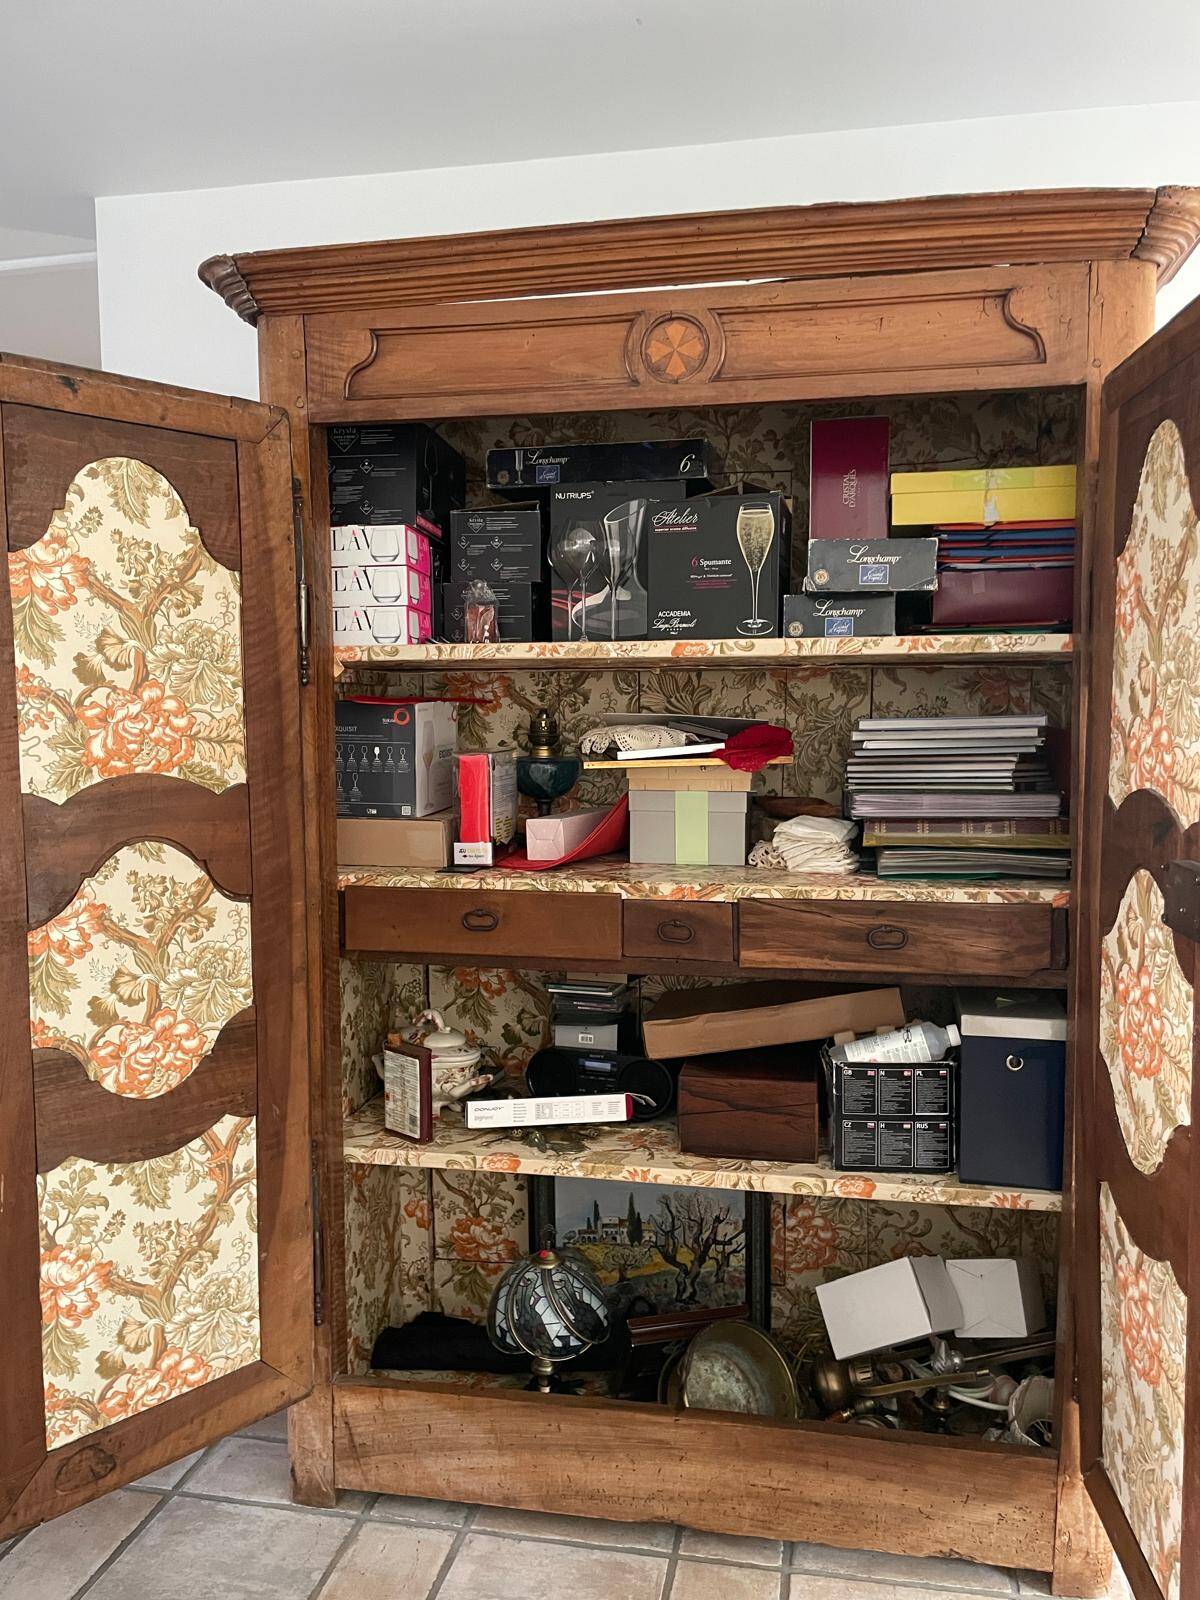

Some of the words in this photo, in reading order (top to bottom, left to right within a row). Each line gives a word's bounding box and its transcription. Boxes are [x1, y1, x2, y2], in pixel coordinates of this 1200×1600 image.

[680, 454, 696, 473] 6
[842, 473, 850, 505] CRISTAL
[651, 507, 698, 527] Atelier
[699, 558, 732, 568] Spumante
[847, 544, 899, 565] Longchamp
[658, 610, 692, 618] ACCADEMIA
[813, 599, 864, 618] Longchamp
